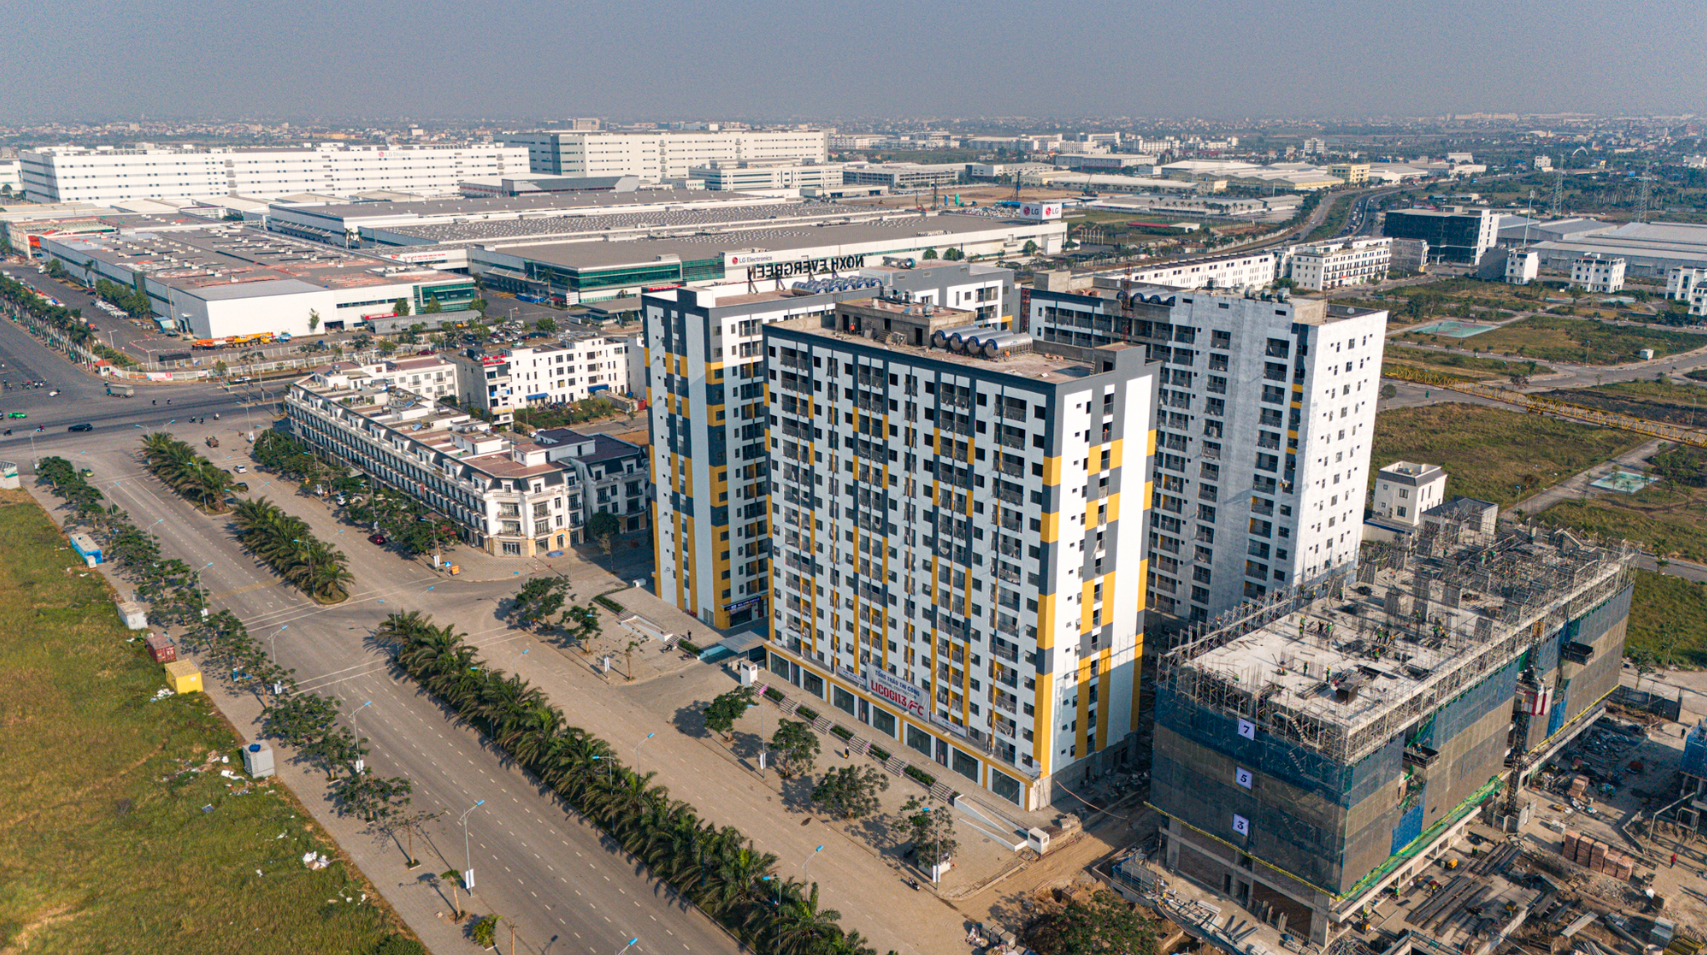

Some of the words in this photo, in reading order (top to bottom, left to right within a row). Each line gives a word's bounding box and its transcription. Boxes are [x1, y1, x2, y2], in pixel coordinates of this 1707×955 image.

[1052, 207, 1059, 215] LG
[747, 255, 772, 263] Electronics
[1243, 725, 1250, 734] 7
[1240, 774, 1247, 783] 5
[1237, 821, 1244, 830] 3
